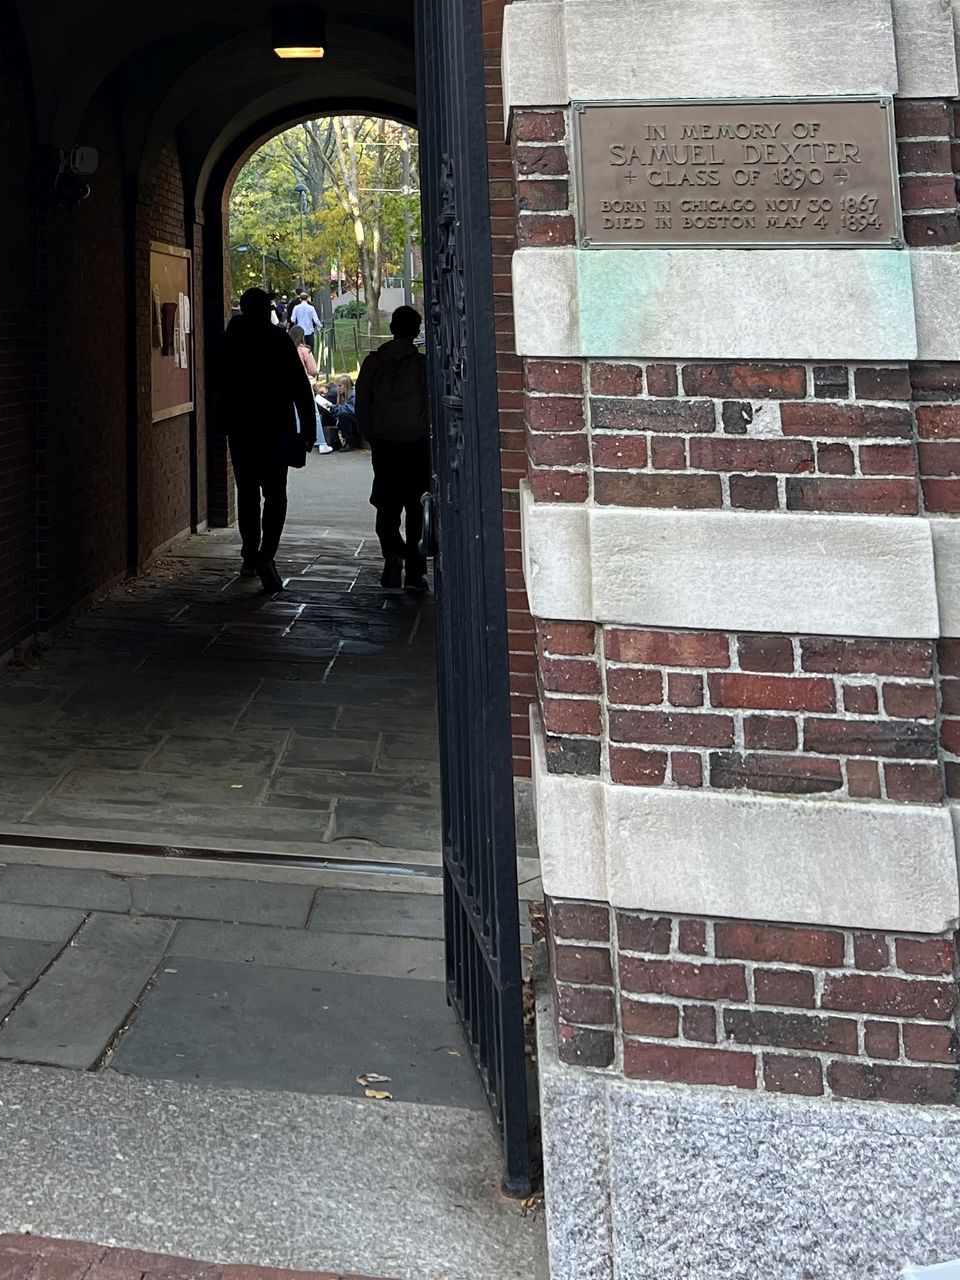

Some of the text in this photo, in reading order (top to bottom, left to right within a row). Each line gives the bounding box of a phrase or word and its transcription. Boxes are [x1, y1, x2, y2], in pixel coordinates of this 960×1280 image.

[644, 122, 821, 140] IN MEMORY OF
[609, 141, 862, 166] SAMUEL DEXTER
[647, 167, 824, 190] CLASS OF 1890
[600, 193, 879, 214] BORN IN CHICAGO NOV 30 1867
[602, 214, 882, 232] DIED IN BOSTON MAY 4 1894
